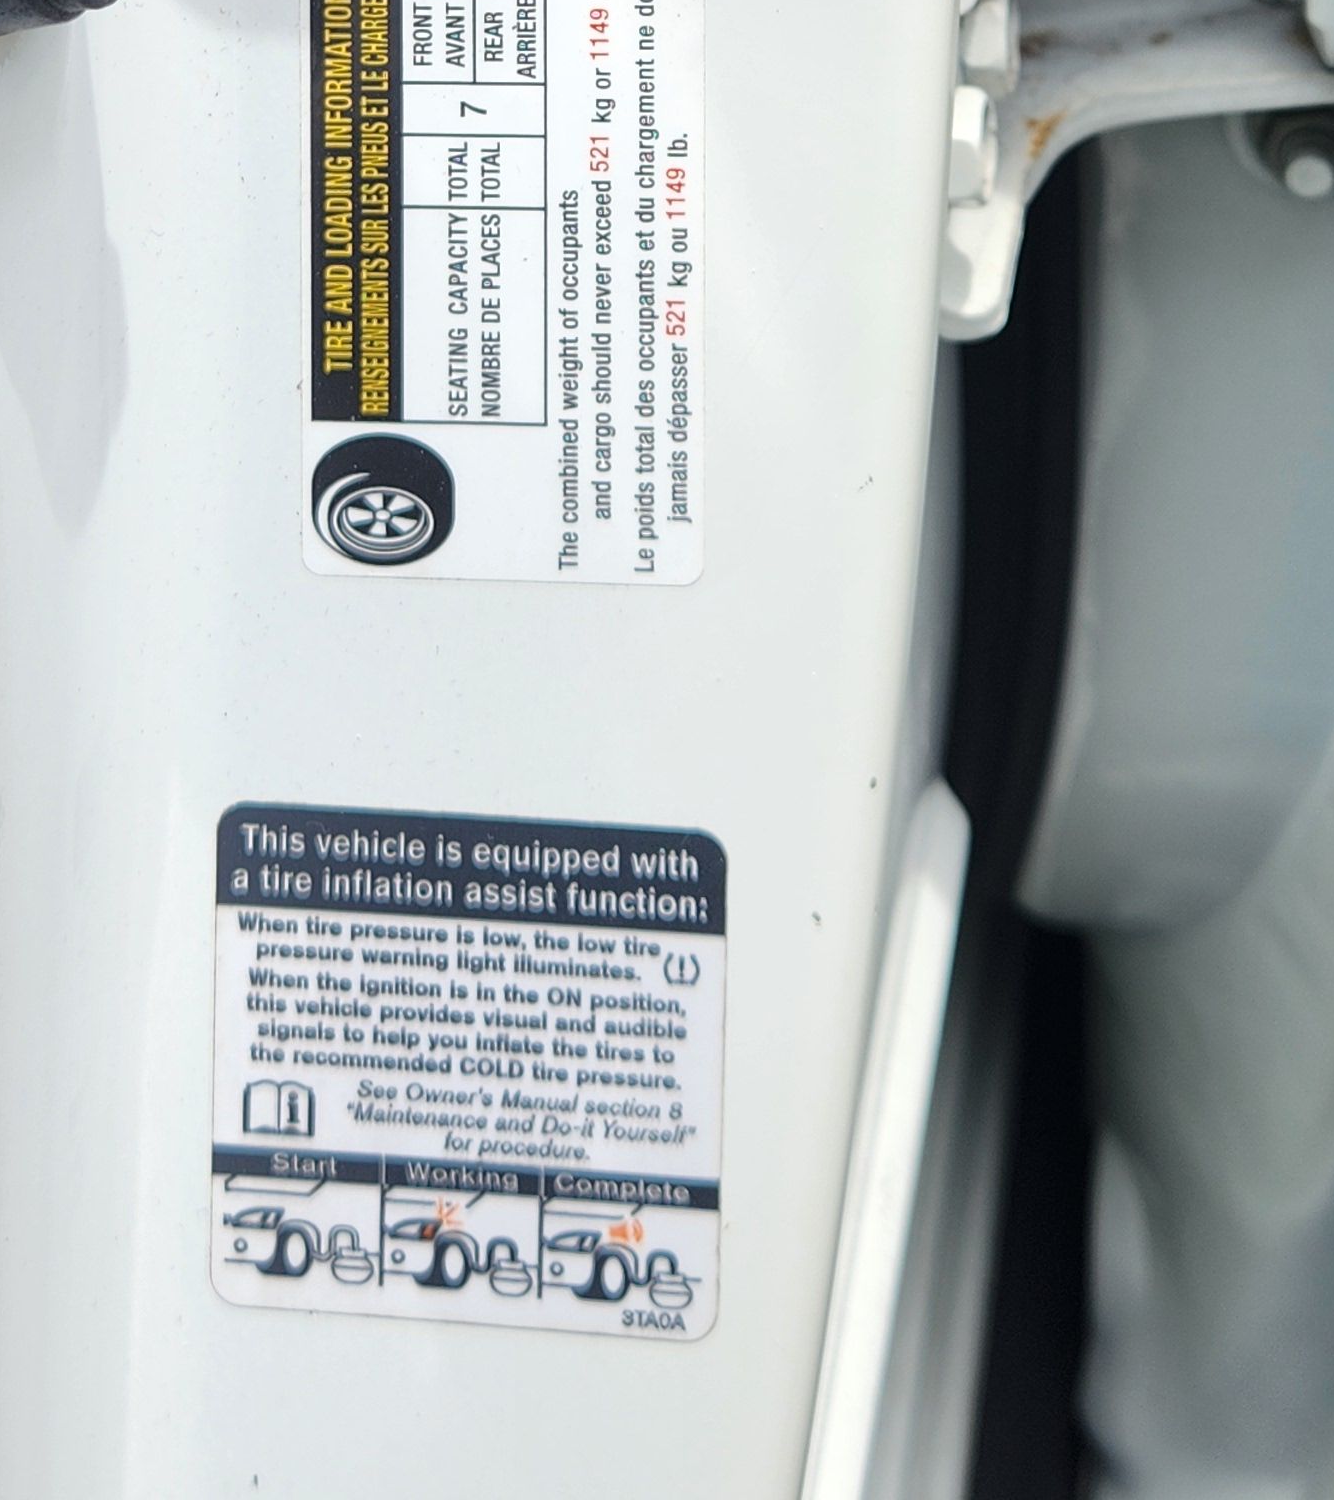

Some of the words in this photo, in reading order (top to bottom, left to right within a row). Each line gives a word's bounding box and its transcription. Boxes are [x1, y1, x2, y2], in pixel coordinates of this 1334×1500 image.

[412, 1, 433, 66] FRONT
[445, 2, 466, 68] AVANT
[483, 12, 504, 62] REAR
[589, 8, 609, 60] 1149
[638, 25, 655, 51] ne
[360, 70, 389, 91] LE
[595, 67, 612, 90] or
[360, 95, 389, 117] ET
[459, 101, 488, 118] 7
[590, 98, 616, 123] kg
[634, 58, 660, 189] chargement
[360, 121, 389, 178] PNEUS
[589, 136, 610, 173] 521
[666, 133, 688, 158] lb.
[447, 141, 468, 202] TOTAL
[480, 142, 501, 203] TOTAL
[665, 167, 686, 220] 1149
[324, 156, 353, 257] LOADING
[360, 182, 389, 215] LES
[590, 180, 612, 256] exceed
[634, 197, 655, 223] du
[360, 219, 389, 254] SUR
[480, 213, 501, 290] PLACES
[558, 189, 584, 301] occupants
[634, 230, 655, 252] et
[671, 227, 688, 253] ou
[447, 212, 469, 315] CAPACITY
[666, 261, 693, 287] kg
[324, 264, 353, 314] AND
[480, 297, 501, 324] DE
[595, 262, 612, 325] never
[360, 257, 390, 414] RENSEIGNEMENTS
[558, 307, 579, 330] of
[634, 259, 660, 372] occupants
[665, 300, 686, 337] 521
[324, 320, 353, 373] TIRE
[590, 332, 612, 405] should
[447, 328, 469, 417] SEATING
[480, 331, 501, 417] NOMBRE
[558, 336, 584, 411] weight
[666, 342, 693, 443] dépasser
[634, 379, 655, 418] des
[595, 412, 616, 473] cargo
[634, 425, 655, 475] total
[558, 418, 579, 524] combined
[666, 450, 693, 524] jamais
[590, 480, 612, 520] and
[634, 481, 660, 541] poids
[557, 531, 579, 571] The
[633, 548, 655, 573] Le
[241, 823, 305, 857] This
[315, 828, 425, 862] vehicle
[437, 834, 462, 867] is
[472, 839, 620, 878] equipped
[631, 847, 699, 882] with
[231, 867, 249, 896] a
[261, 863, 312, 898] tire
[322, 867, 453, 906] inflation
[465, 879, 556, 909] assist
[567, 882, 708, 923] function:
[238, 911, 298, 934] When
[306, 916, 342, 935] tire
[350, 922, 448, 943] pressure
[456, 924, 475, 945] is
[483, 927, 526, 951] low,
[534, 930, 570, 951] the
[577, 932, 616, 954] low
[623, 936, 661, 956] tire
[248, 966, 308, 989] When
[317, 972, 352, 991] the
[360, 974, 441, 997] ignition
[450, 980, 468, 998] is
[477, 982, 495, 1001] in
[503, 982, 538, 1004] the
[547, 987, 582, 1006] ON
[589, 992, 687, 1017] position,
[250, 1042, 284, 1063] the
[293, 1049, 452, 1074] recommended
[460, 1057, 524, 1079] COLD
[532, 1062, 568, 1081] tire
[576, 1067, 681, 1090] pressure.
[357, 1080, 398, 1100] See
[406, 1084, 493, 1107] Owner's
[501, 1091, 578, 1113] Manual
[584, 1098, 659, 1118] section
[443, 1132, 473, 1152] for
[478, 1138, 591, 1161] procedure.
[495, 1113, 535, 1133] and
[542, 1116, 594, 1137] Do-it
[272, 1152, 338, 1177] Start
[405, 1161, 519, 1192] Working
[554, 1173, 691, 1204] Complete
